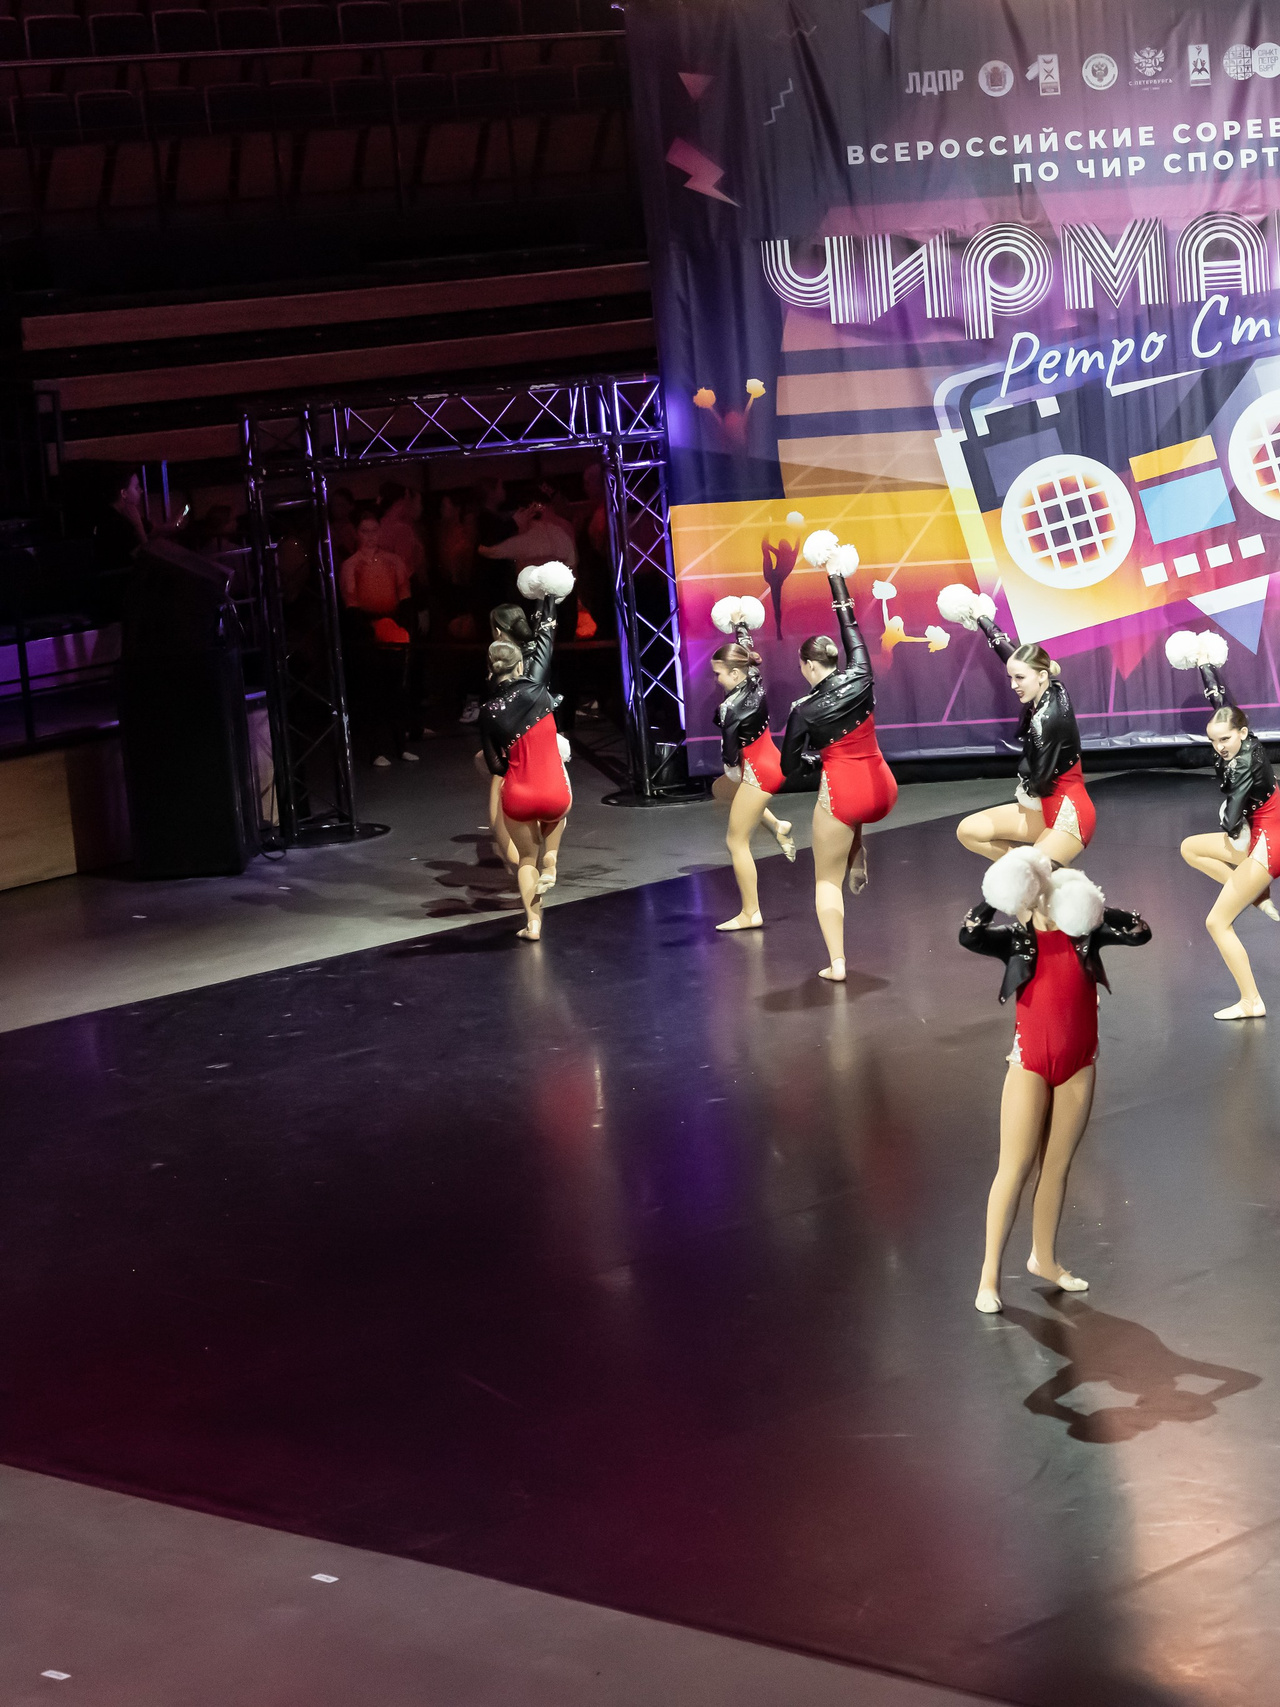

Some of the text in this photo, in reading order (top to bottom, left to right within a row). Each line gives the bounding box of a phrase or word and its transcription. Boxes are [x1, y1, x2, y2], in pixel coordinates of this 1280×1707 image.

[1258, 49, 1278, 57] САНКТ
[1258, 56, 1279, 64] ПЕТЕР
[1259, 64, 1276, 72] БУРГ
[905, 69, 964, 96] ЛДПР
[846, 125, 1155, 166] ВСЕРОССИЙСКИЕ
[1012, 161, 1059, 184] ПО
[1075, 155, 1147, 179] ЧИР
[1000, 331, 1168, 398] Ретро
